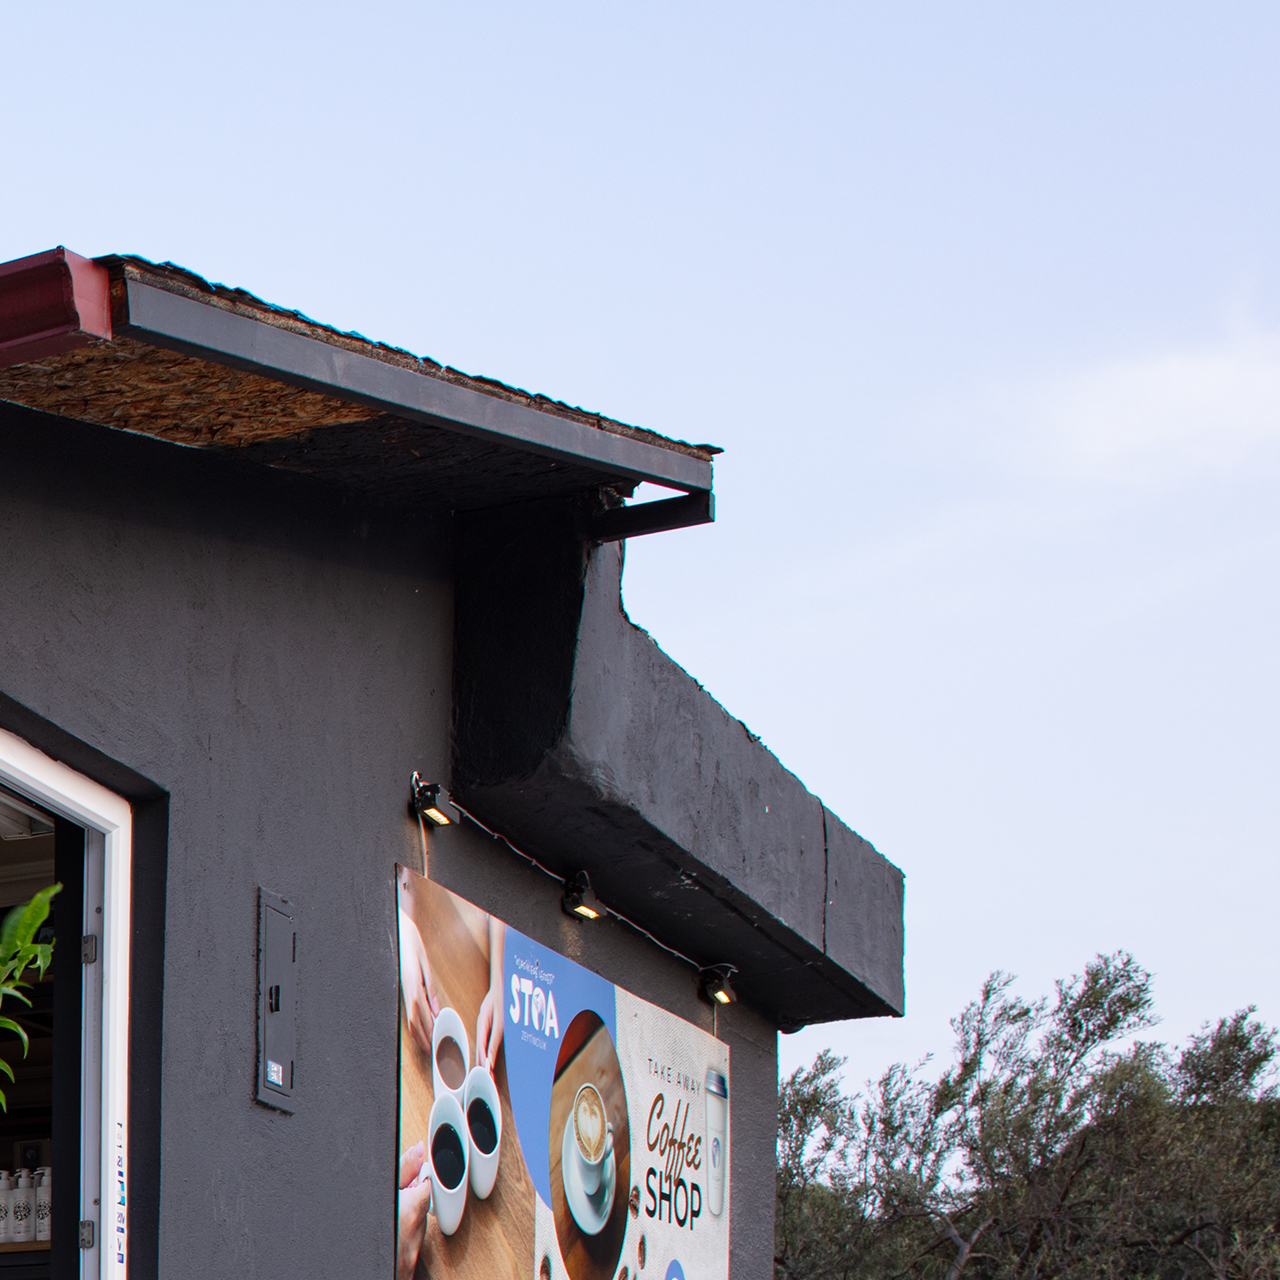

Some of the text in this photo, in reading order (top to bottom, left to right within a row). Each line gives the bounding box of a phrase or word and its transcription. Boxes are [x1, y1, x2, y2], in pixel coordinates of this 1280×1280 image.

[509, 973, 560, 1039] STOA
[647, 1058, 702, 1097] TAKE AWAY
[646, 1092, 703, 1188] Coffee
[645, 1166, 704, 1231] SHOP
